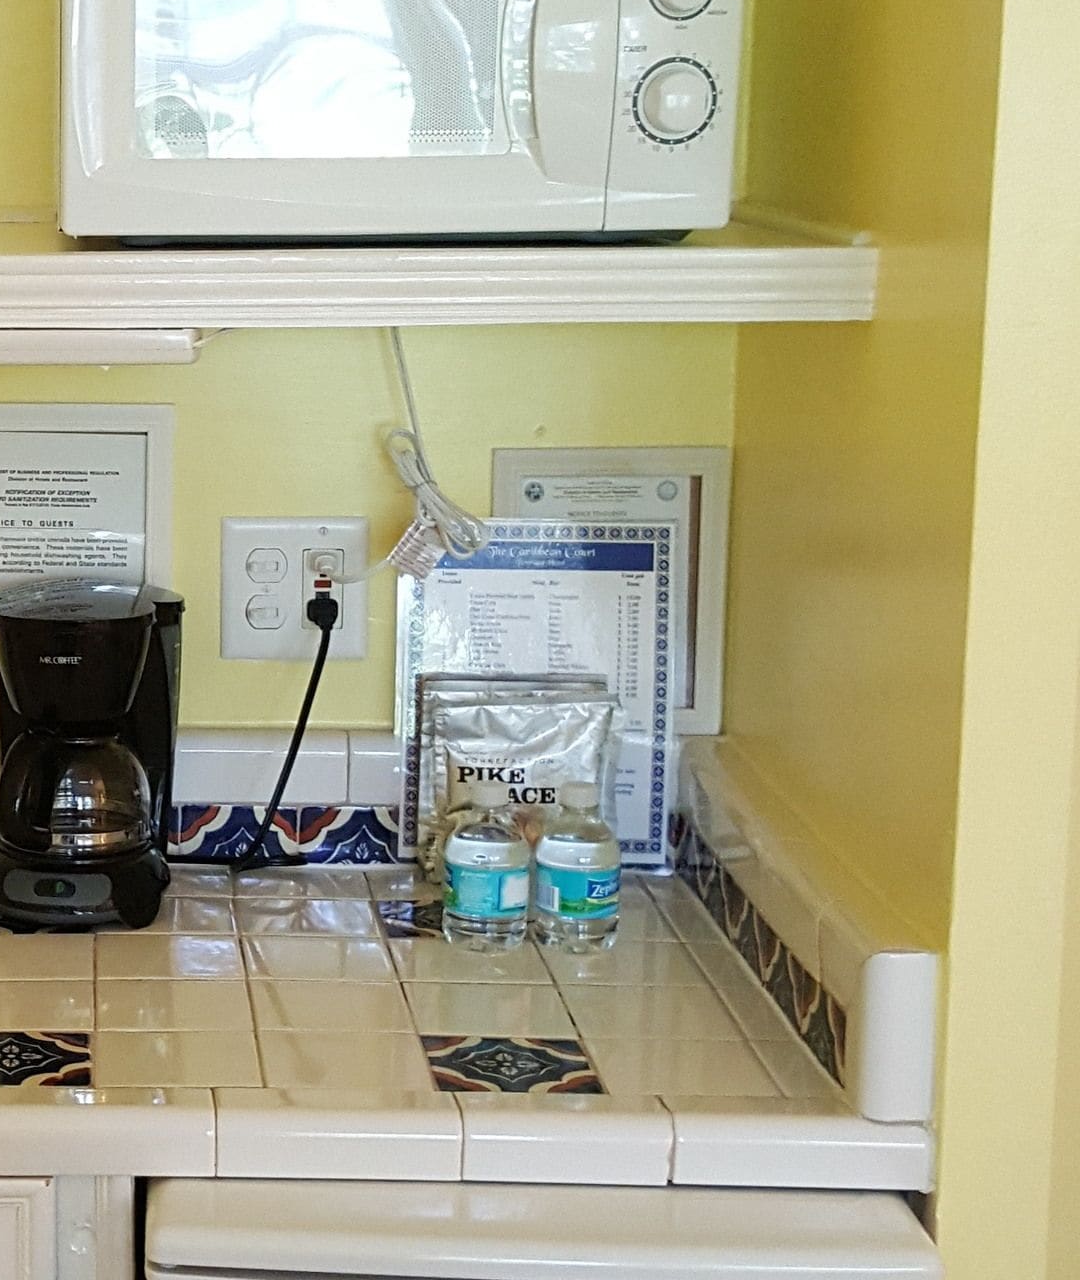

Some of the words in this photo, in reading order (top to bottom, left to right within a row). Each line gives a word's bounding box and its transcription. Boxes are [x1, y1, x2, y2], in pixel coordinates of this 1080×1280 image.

[22, 519, 33, 527] TO
[39, 520, 75, 528] GUESTS
[487, 545, 506, 558] The
[564, 546, 597, 558] Court
[457, 766, 525, 784] PIKE
[507, 787, 556, 805] ACE
